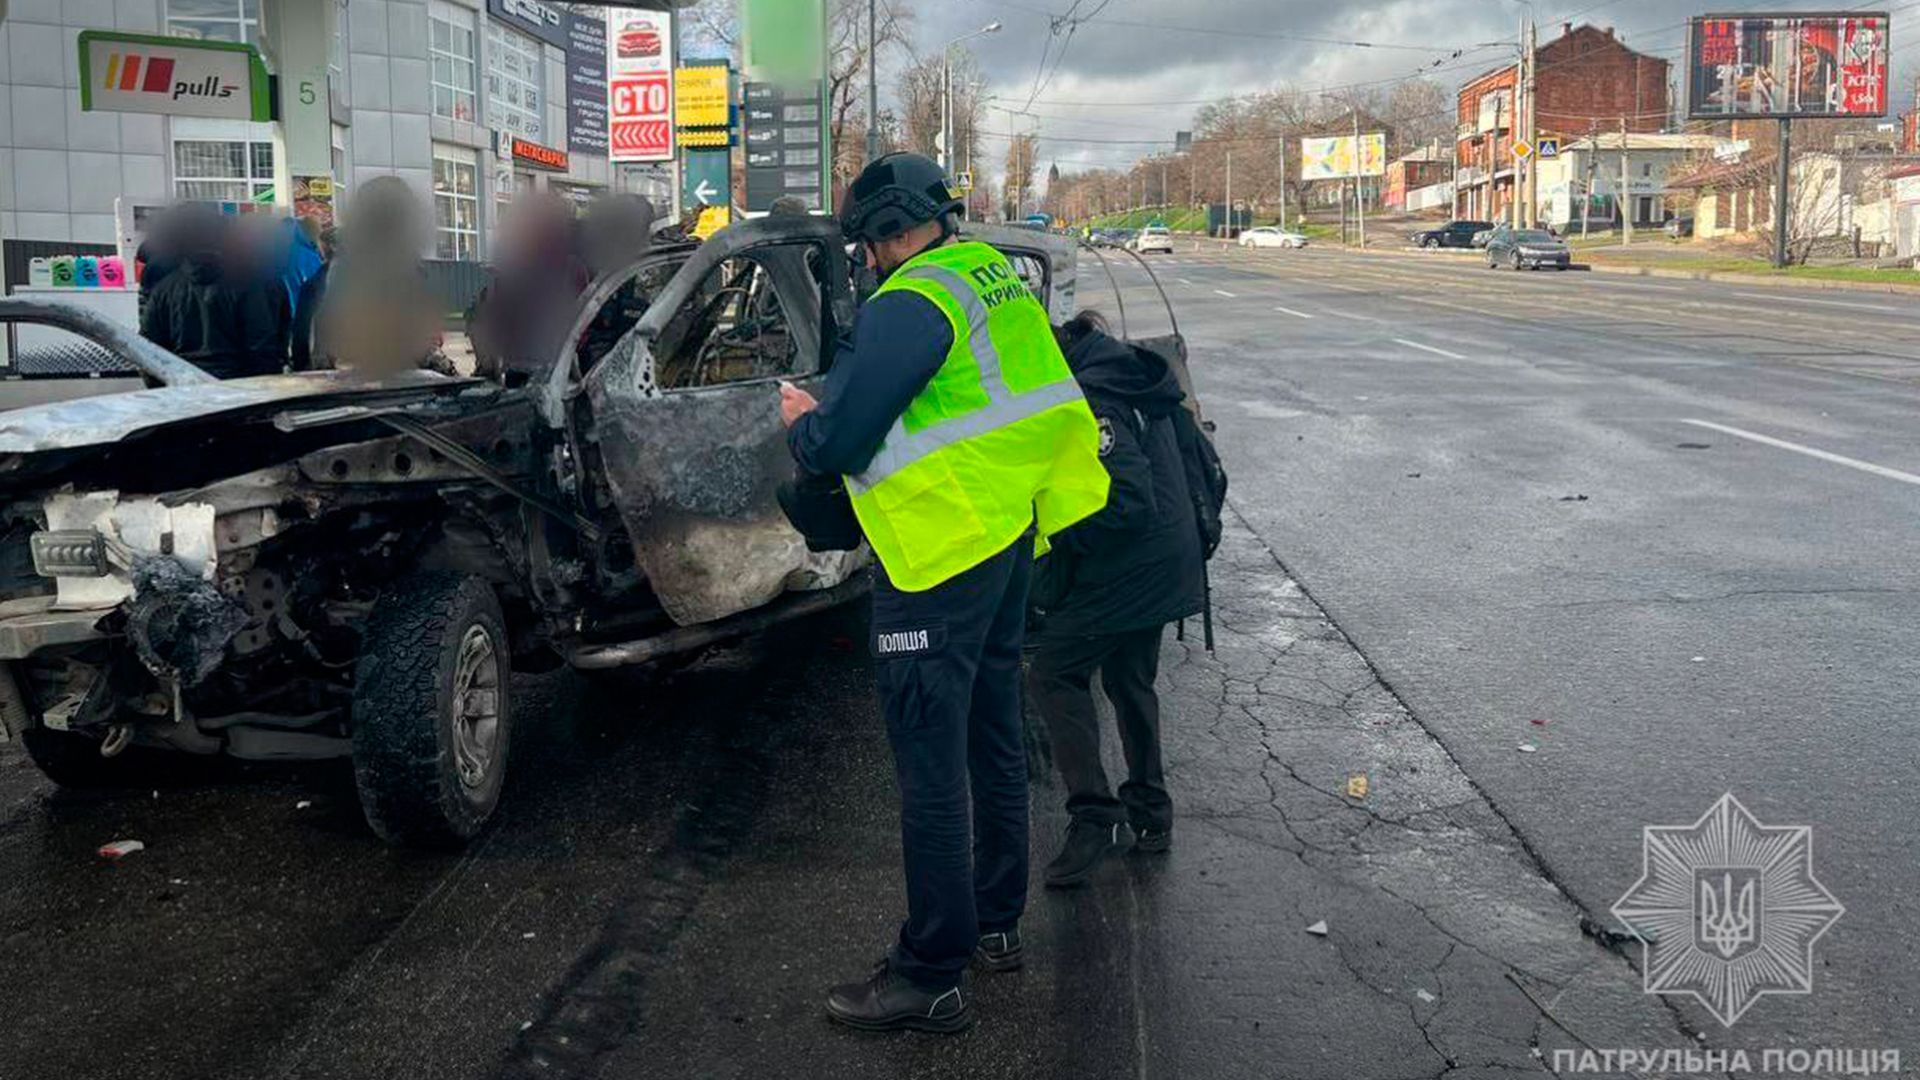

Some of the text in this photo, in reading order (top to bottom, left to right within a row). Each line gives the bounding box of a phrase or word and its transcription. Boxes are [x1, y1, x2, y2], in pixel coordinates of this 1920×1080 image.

[173, 76, 240, 100] pulls
[300, 81, 315, 104] 5
[614, 84, 666, 114] СТО
[878, 629, 929, 653] ПОЛІЦІЯ
